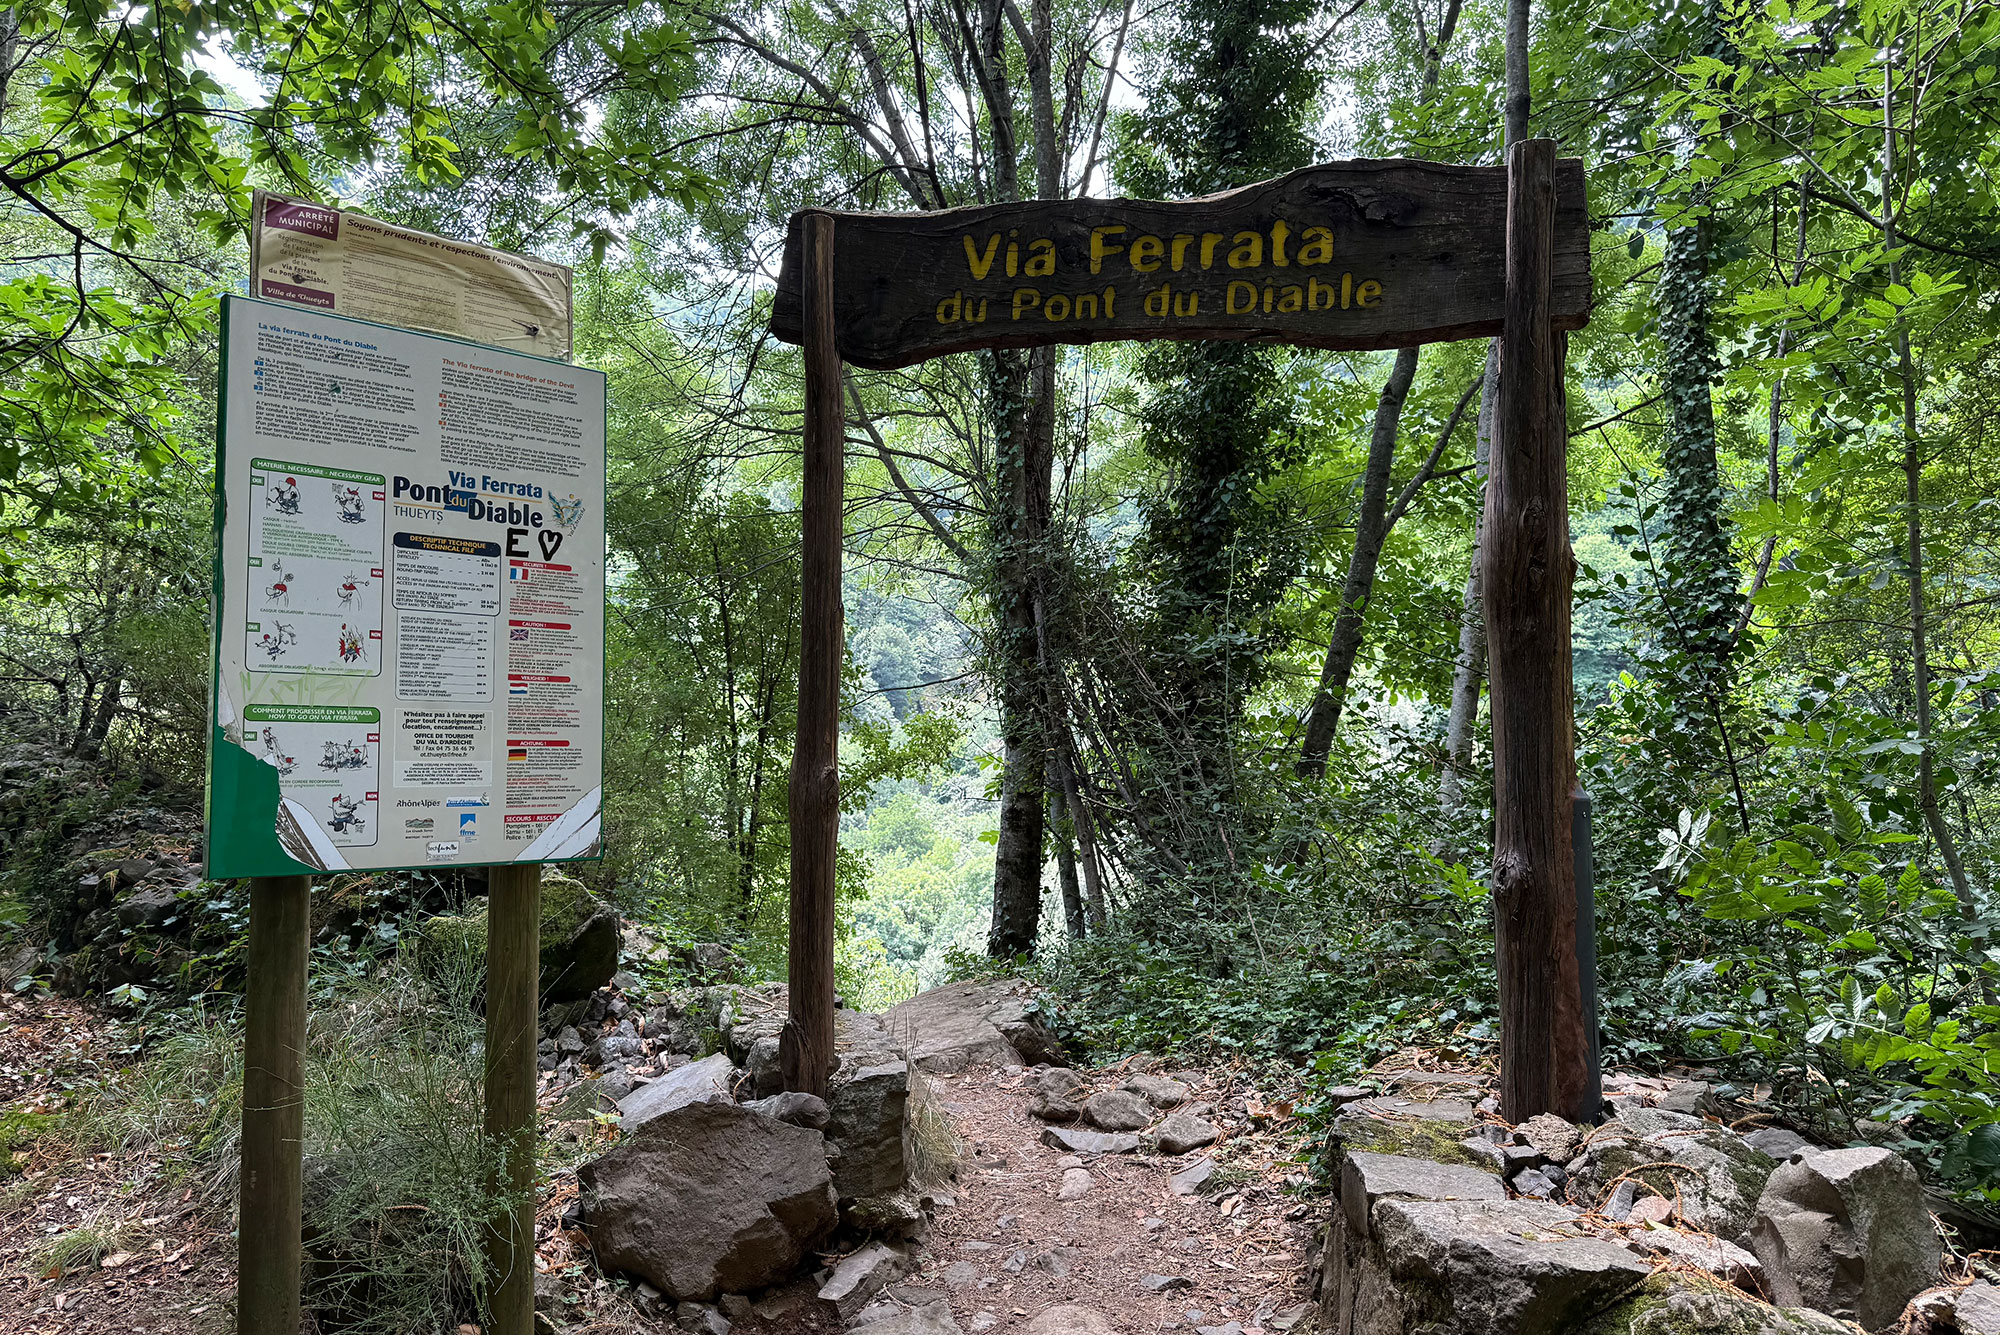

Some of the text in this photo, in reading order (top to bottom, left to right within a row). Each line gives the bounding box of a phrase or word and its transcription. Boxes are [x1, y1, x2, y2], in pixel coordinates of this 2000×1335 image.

[278, 217, 334, 234] MUNICIPAL
[298, 210, 334, 224] ARRÊTÉ
[346, 218, 382, 234] Soyons
[383, 229, 428, 248] prudents
[429, 240, 440, 249] et
[441, 243, 490, 262] respectons
[962, 218, 1336, 281] Via Ferrata
[292, 258, 301, 266] de
[295, 252, 320, 264] pratique
[266, 287, 284, 296] Ville
[298, 293, 330, 306] Thueyts
[935, 270, 1383, 324] du Pont du Diable
[270, 324, 280, 332] via
[282, 326, 309, 337] ferrata
[311, 332, 321, 340] du
[323, 334, 341, 343] Pont
[354, 340, 377, 350] Diable
[442, 358, 455, 366] The
[457, 360, 468, 369] Via
[470, 362, 494, 374] ferrata
[496, 368, 503, 376] of
[504, 370, 514, 378] the
[516, 372, 538, 384] bridge
[548, 378, 558, 386] the
[559, 380, 575, 389] Devil
[257, 460, 286, 470] MATERIEL
[288, 464, 324, 475] NECESSAIRE
[330, 470, 363, 480] NECESSARY
[448, 470, 543, 499] Via Ferrata
[393, 476, 544, 529] Pont du Diable
[394, 506, 444, 522] THUEYTS
[410, 535, 486, 549] DESCRIPTIF TECHNIQUE
[422, 542, 460, 552] TECHNICAL
[505, 527, 530, 558] E
